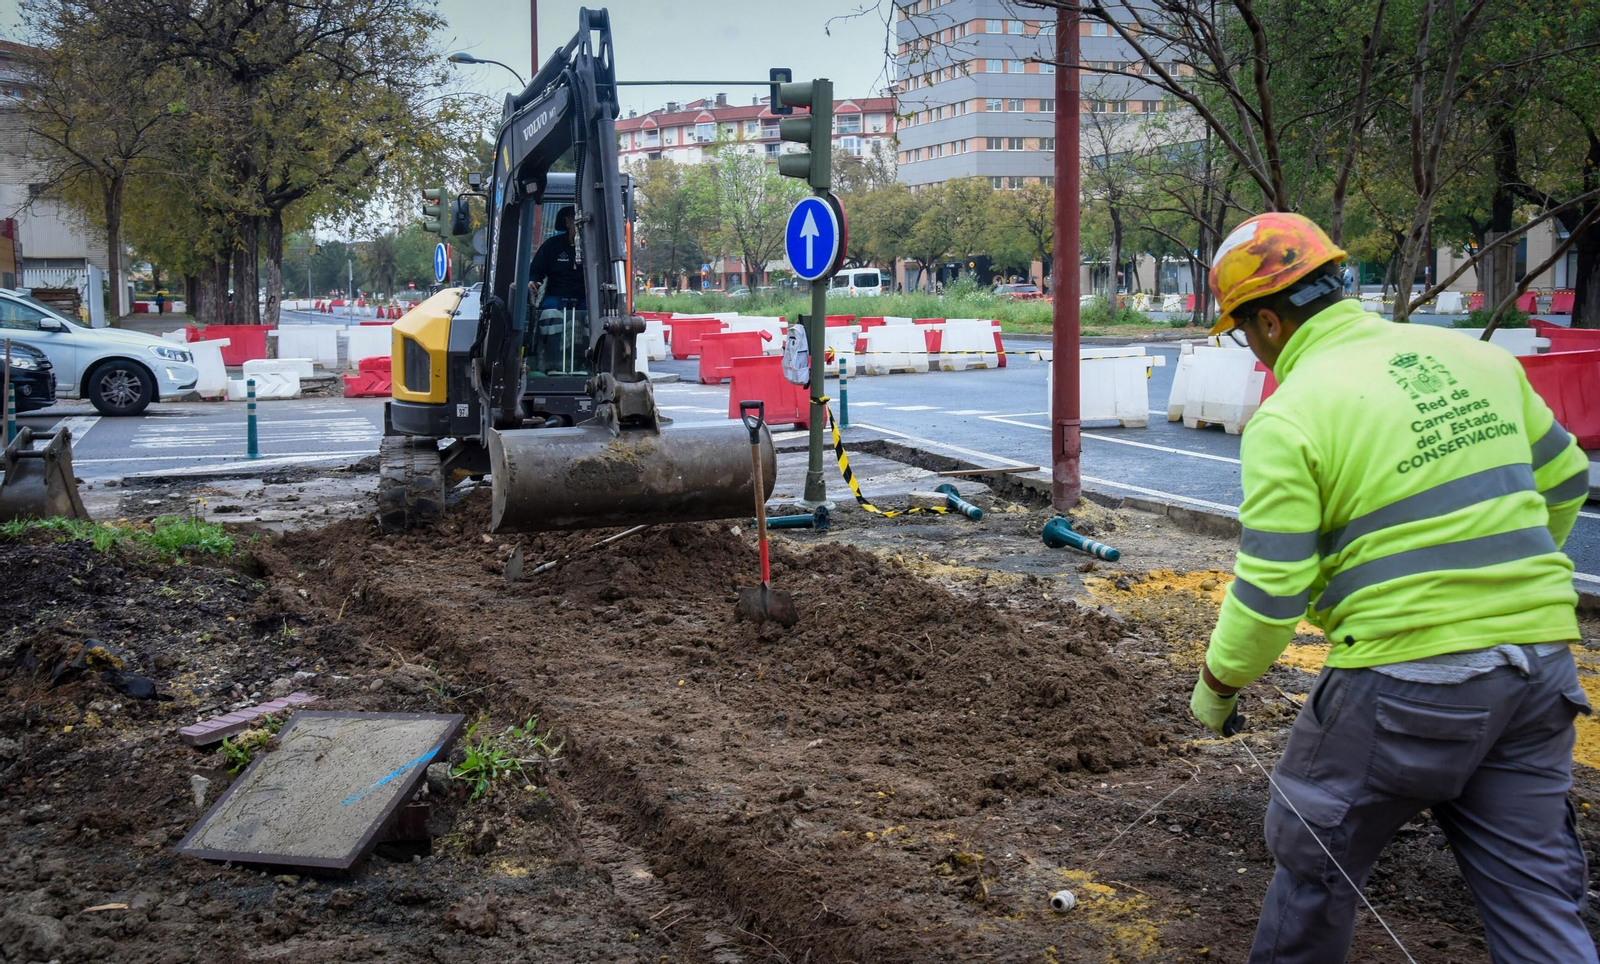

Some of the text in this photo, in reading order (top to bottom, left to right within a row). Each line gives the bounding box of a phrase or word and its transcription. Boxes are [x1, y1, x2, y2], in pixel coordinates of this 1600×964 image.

[523, 111, 548, 141] VOLVO
[458, 408, 465, 417] 97
[1411, 398, 1490, 433] Carreteras
[1415, 388, 1469, 414] Red de
[1416, 411, 1498, 450] del Estado
[1396, 420, 1518, 474] CONSERVACIÓN
